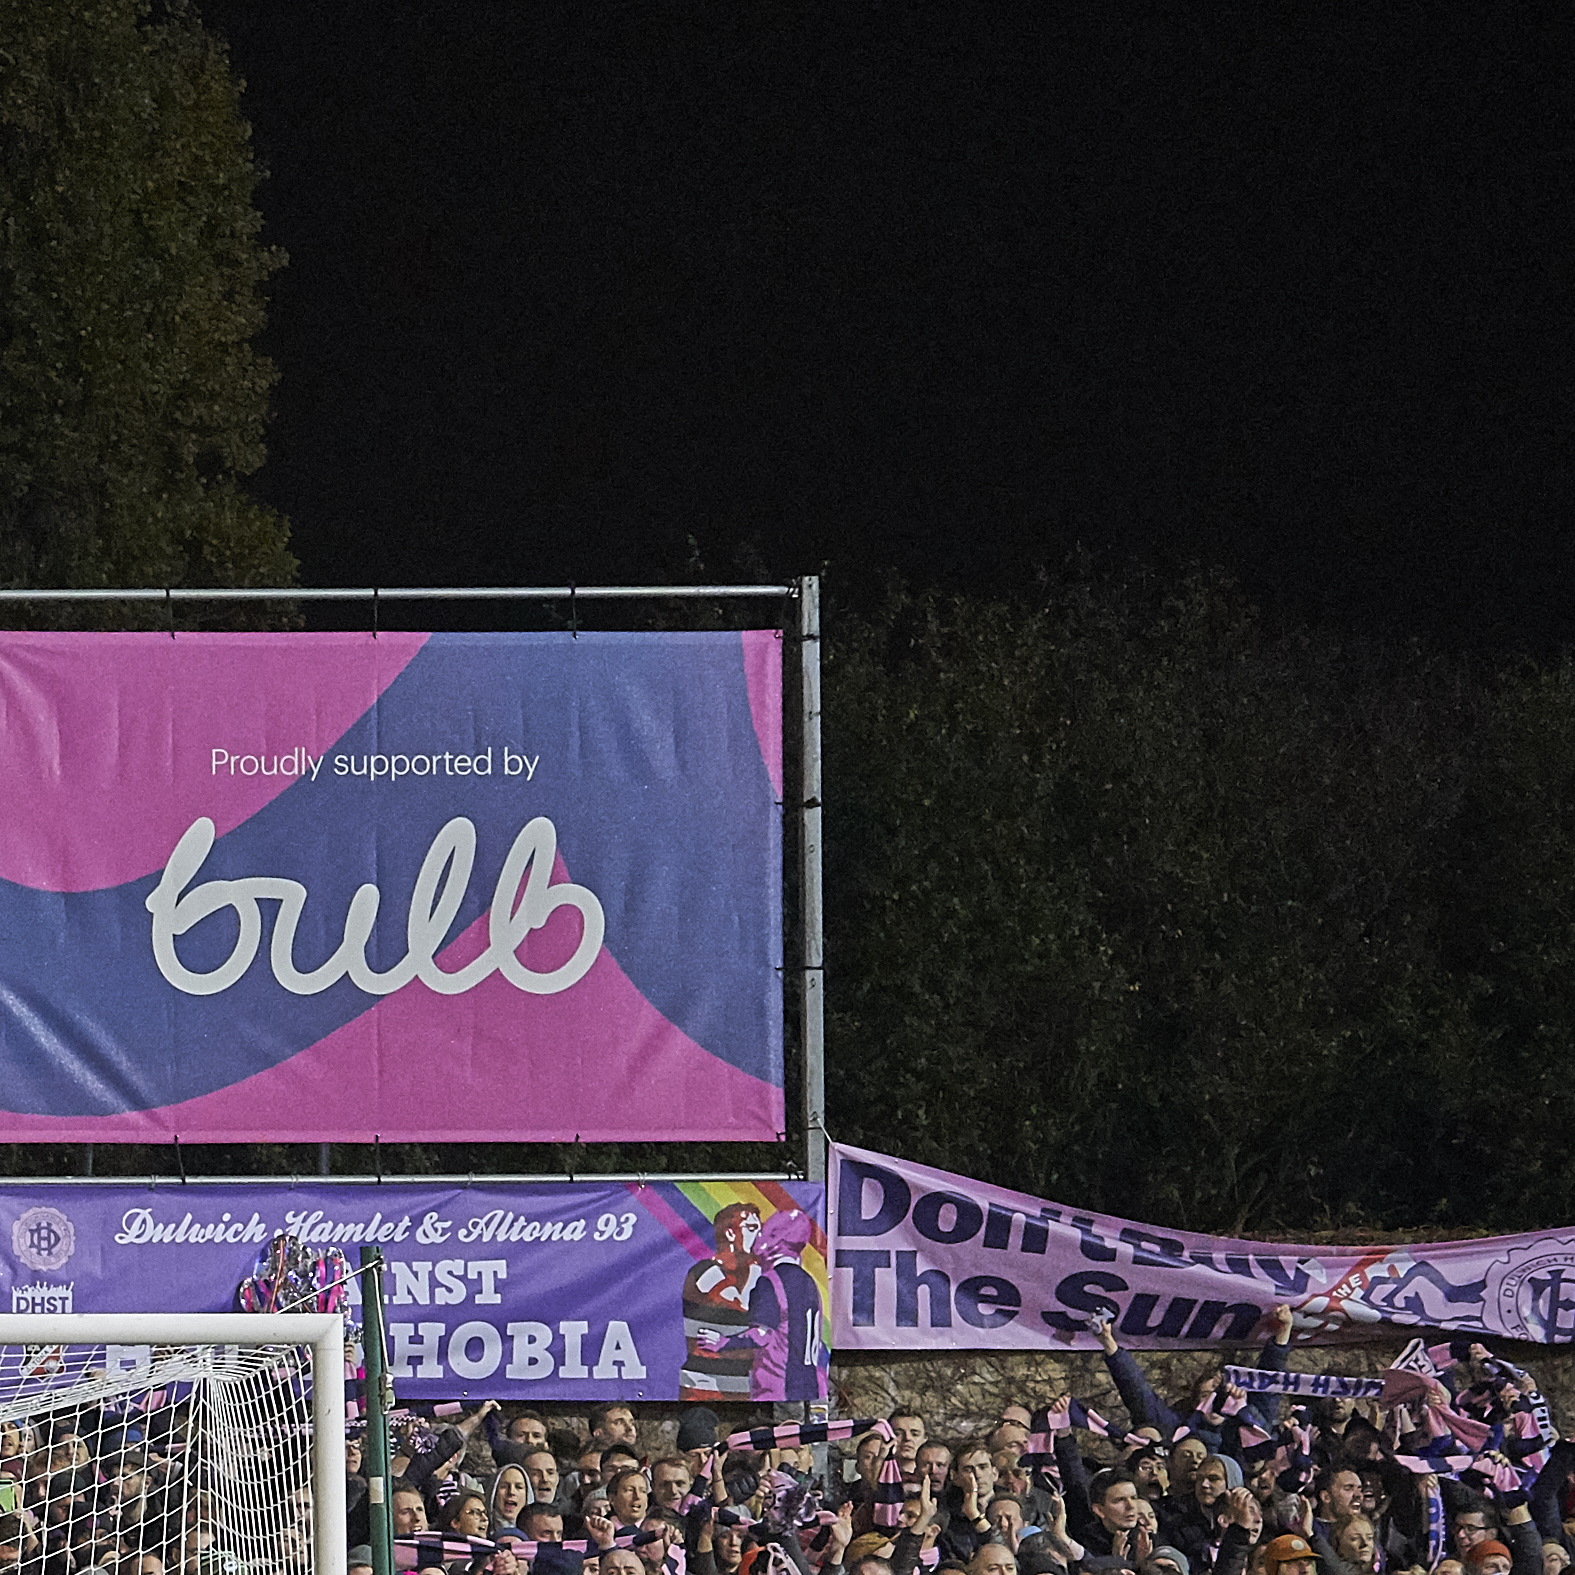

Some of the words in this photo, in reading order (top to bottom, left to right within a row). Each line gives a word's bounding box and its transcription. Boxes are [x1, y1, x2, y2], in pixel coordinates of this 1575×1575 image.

[211, 748, 323, 781] Proudly
[333, 747, 492, 781] supported
[504, 748, 539, 781] by
[145, 816, 605, 995] bulb
[114, 1208, 267, 1244] Dulwich
[274, 1211, 411, 1243] Hamlet
[415, 1213, 452, 1244] &
[458, 1210, 587, 1244] Altona
[594, 1213, 637, 1242] 93
[17, 1297, 69, 1313] DHST
[835, 1249, 1022, 1329] The
[1040, 1270, 1262, 1339] Sun
